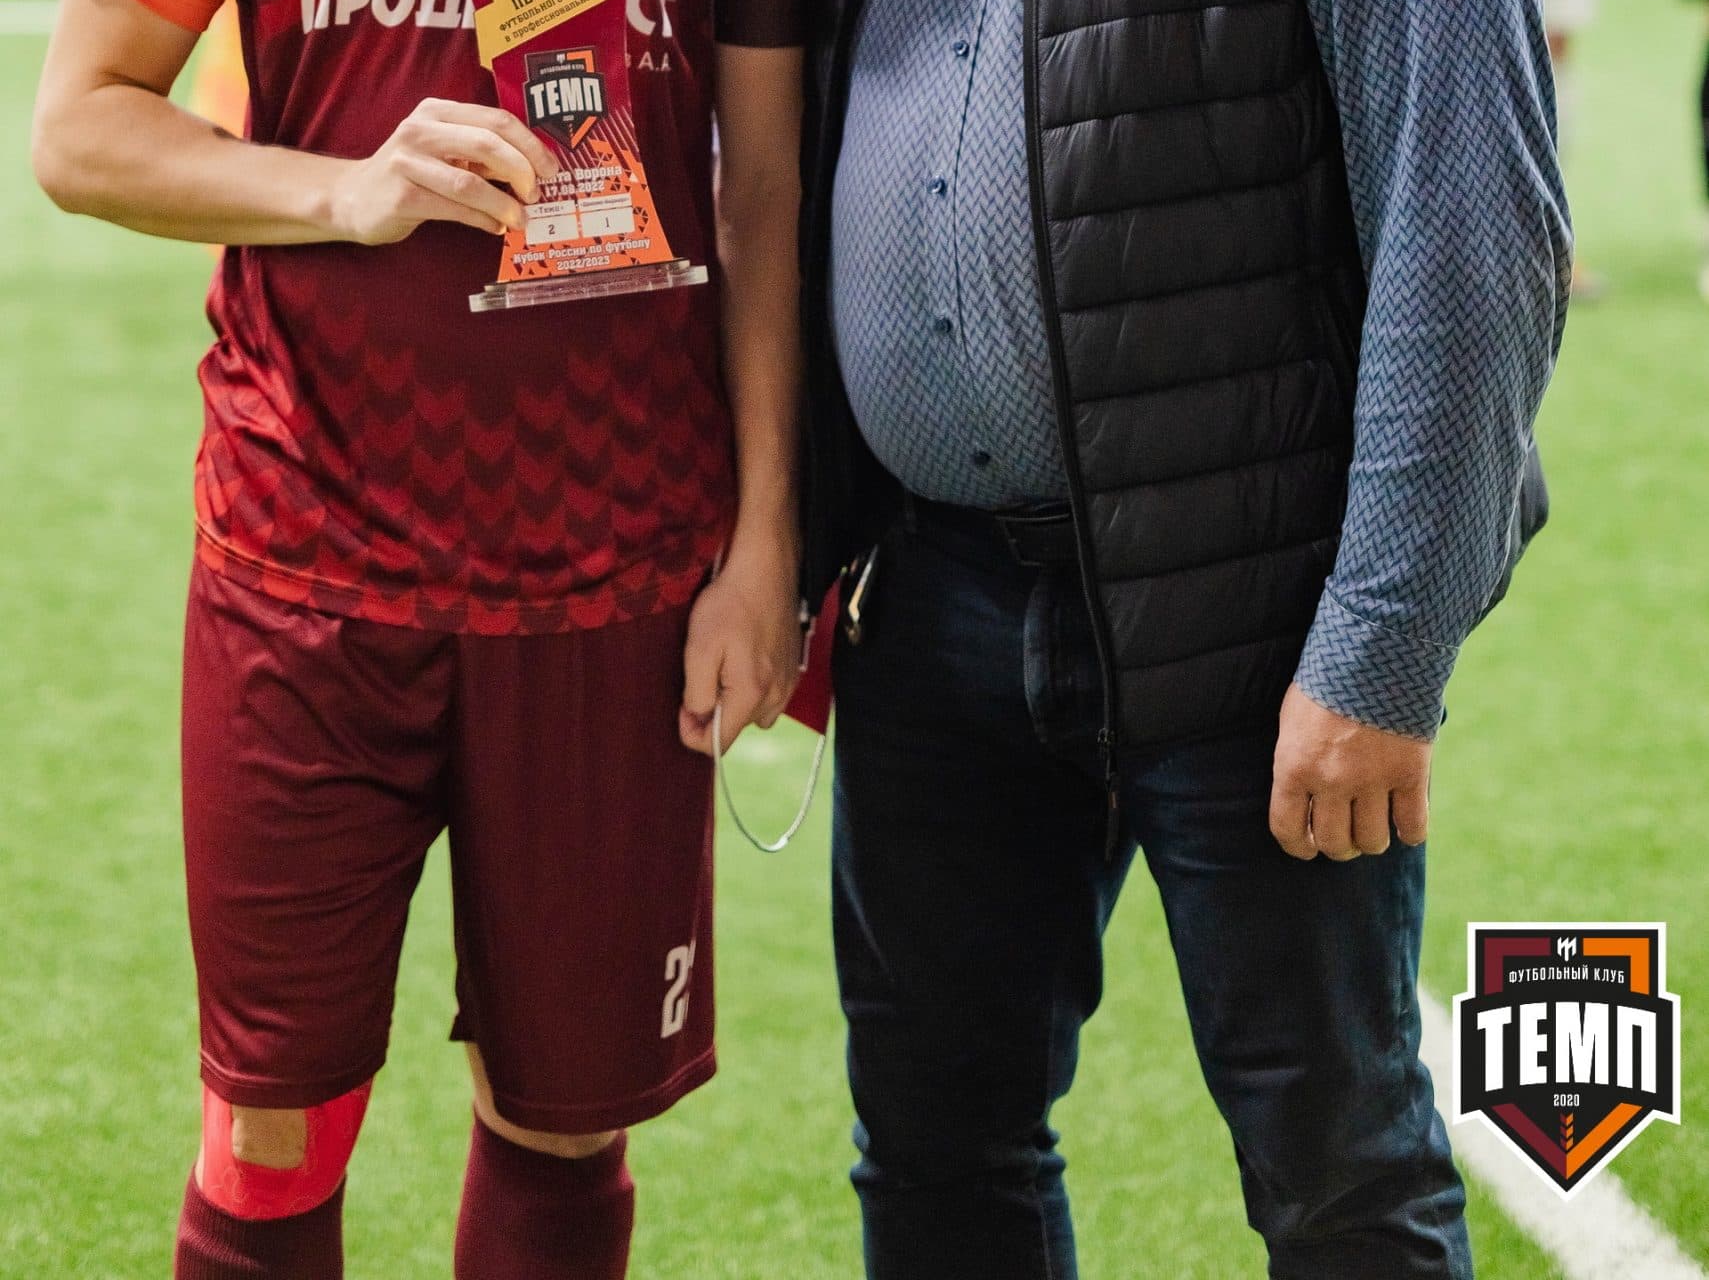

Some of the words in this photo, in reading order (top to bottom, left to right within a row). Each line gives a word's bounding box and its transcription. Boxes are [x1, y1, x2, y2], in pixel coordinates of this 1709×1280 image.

[529, 77, 603, 119] ТЕМП
[575, 166, 622, 181] Ворона
[548, 224, 555, 235] 2
[548, 247, 587, 258] России
[588, 245, 603, 254] по
[605, 239, 651, 253] футболу
